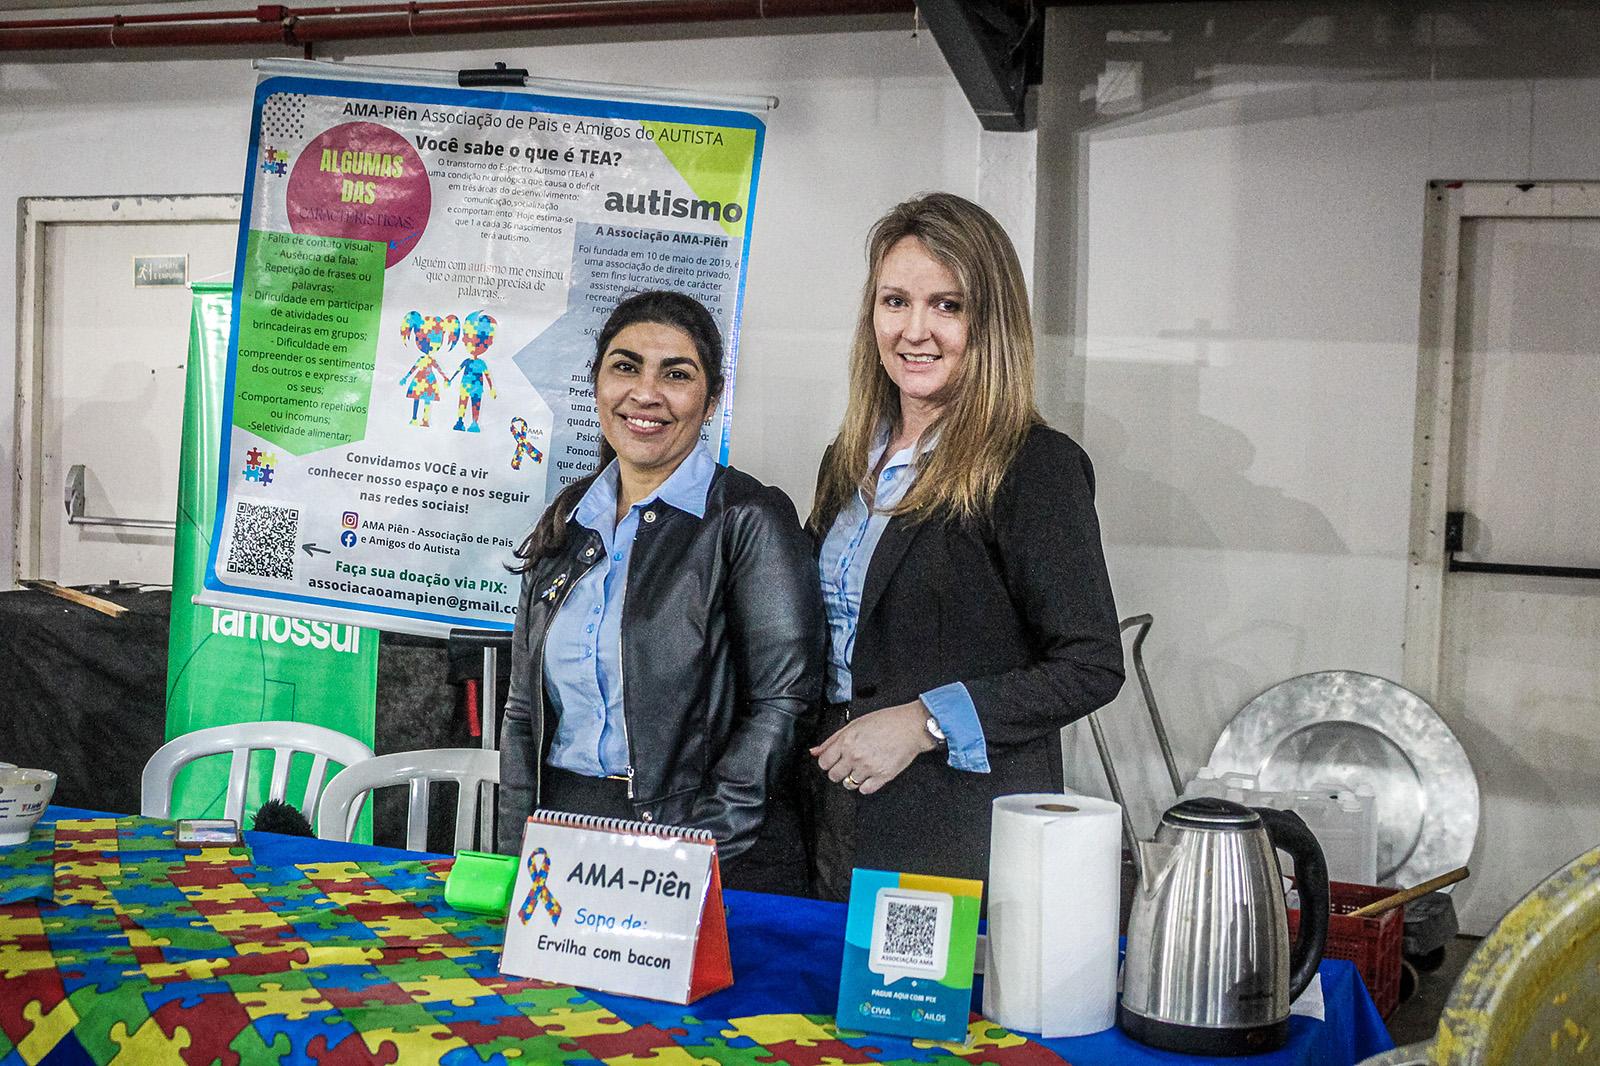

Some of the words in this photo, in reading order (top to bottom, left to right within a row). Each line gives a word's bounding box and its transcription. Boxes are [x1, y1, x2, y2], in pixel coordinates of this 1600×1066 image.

[343, 102, 417, 120] AMA-Piên
[421, 109, 502, 130] Associação
[506, 115, 524, 129] de
[528, 117, 558, 132] Pais
[563, 123, 570, 133] e
[574, 121, 630, 140] Amigos
[636, 126, 654, 140] do
[659, 128, 723, 146] AUTISTA
[415, 135, 458, 152] Você
[464, 141, 504, 156] sabe
[510, 146, 520, 157] o
[525, 148, 558, 163] que
[564, 147, 574, 162] é
[580, 149, 622, 166] TEA?
[320, 148, 404, 178] ALGUMAS
[446, 160, 486, 169] transtorno
[534, 167, 566, 176] Autismo
[568, 170, 588, 179] (TEA)
[342, 179, 376, 205] DAS
[478, 185, 497, 193] áreas
[500, 187, 510, 197] do
[512, 188, 579, 200] desenvolvimento:
[605, 190, 742, 223] autismo
[482, 221, 500, 230] cada
[502, 220, 512, 230] 36
[268, 232, 290, 244] Falta
[292, 236, 304, 247] de
[306, 239, 342, 249] contato
[344, 241, 374, 253] visual;
[498, 234, 531, 243] autismo.
[596, 226, 603, 236] A
[606, 227, 669, 243] Associação
[672, 234, 728, 247] AMA-Piên
[280, 249, 321, 262] Ausência
[323, 254, 336, 265] da
[339, 254, 358, 266] fala;
[579, 245, 591, 253] Foi
[594, 246, 628, 257] fundada
[648, 252, 657, 260] 10
[659, 253, 670, 261] de
[672, 255, 694, 264] maio
[696, 257, 706, 265] de
[709, 258, 732, 268] 2019,
[265, 262, 310, 276] Repetição
[313, 267, 324, 277] de
[327, 269, 356, 280] frases
[412, 256, 446, 270] Alguém
[448, 261, 466, 270] com
[468, 263, 506, 274] autismo
[509, 267, 524, 276] me
[525, 268, 563, 280] ensinou
[606, 260, 651, 272] associação
[653, 264, 664, 273] de
[666, 265, 694, 276] direito
[696, 269, 730, 280] privado,
[292, 280, 334, 295] palavras;
[426, 272, 442, 283] que
[452, 274, 476, 283] amor
[478, 276, 495, 286] não
[497, 278, 531, 289] precisa
[534, 280, 545, 291] de
[611, 271, 626, 280] fins
[629, 273, 672, 286] lucrativos,
[674, 277, 685, 287] de
[687, 281, 722, 290] carácter
[255, 290, 307, 305] Dificuldade
[310, 298, 325, 306] em
[328, 298, 374, 312] participar
[458, 285, 504, 301] palavras...
[271, 307, 282, 317] de
[285, 309, 333, 322] atividades
[253, 320, 311, 334] brincadeiras
[331, 330, 367, 341] grupos;
[277, 337, 330, 351] Dificuldade
[239, 349, 302, 363] compreender
[304, 356, 316, 364] os
[319, 358, 375, 371] sentimentos
[252, 364, 268, 374] dos
[272, 368, 302, 377] outros
[313, 372, 357, 383] expressar
[300, 385, 324, 395] seus;
[238, 391, 318, 408] -Comportamento
[321, 401, 367, 414] repetitivos
[571, 402, 592, 412] uma
[285, 410, 330, 425] incomuns;
[567, 417, 600, 430] quadro
[248, 421, 305, 436] -Seletividade
[308, 429, 351, 443] alimentar;
[347, 452, 420, 470] Convidamos
[425, 462, 456, 475] VOCÊ
[460, 469, 467, 477] a
[471, 468, 488, 479] vir
[308, 467, 363, 481] conhecer
[367, 475, 401, 486] nosso
[405, 480, 448, 495] espaço
[451, 486, 458, 494] e
[462, 488, 485, 497] nos
[489, 491, 530, 504] seguir
[360, 492, 381, 502] nas
[385, 495, 418, 507] redes
[422, 500, 468, 514] sociais!
[362, 521, 385, 531] AMA
[388, 524, 409, 534] Piên
[418, 528, 473, 543] Associação
[477, 535, 489, 544] de
[493, 537, 513, 547] Pais
[369, 536, 405, 549] Amigos
[409, 541, 421, 550] do
[424, 543, 460, 555] Autista
[336, 561, 366, 577] Faça
[371, 568, 395, 579] sua
[400, 569, 450, 587] doação
[454, 577, 476, 590] via
[480, 580, 507, 594] PIX:
[309, 579, 518, 614] associacaoamapien@gmail.co
[567, 862, 690, 900] AMA-Piên
[538, 935, 586, 956] Ervilha
[593, 948, 620, 962] com
[628, 948, 670, 969] bacon
[872, 1006, 891, 1015] CIVIA
